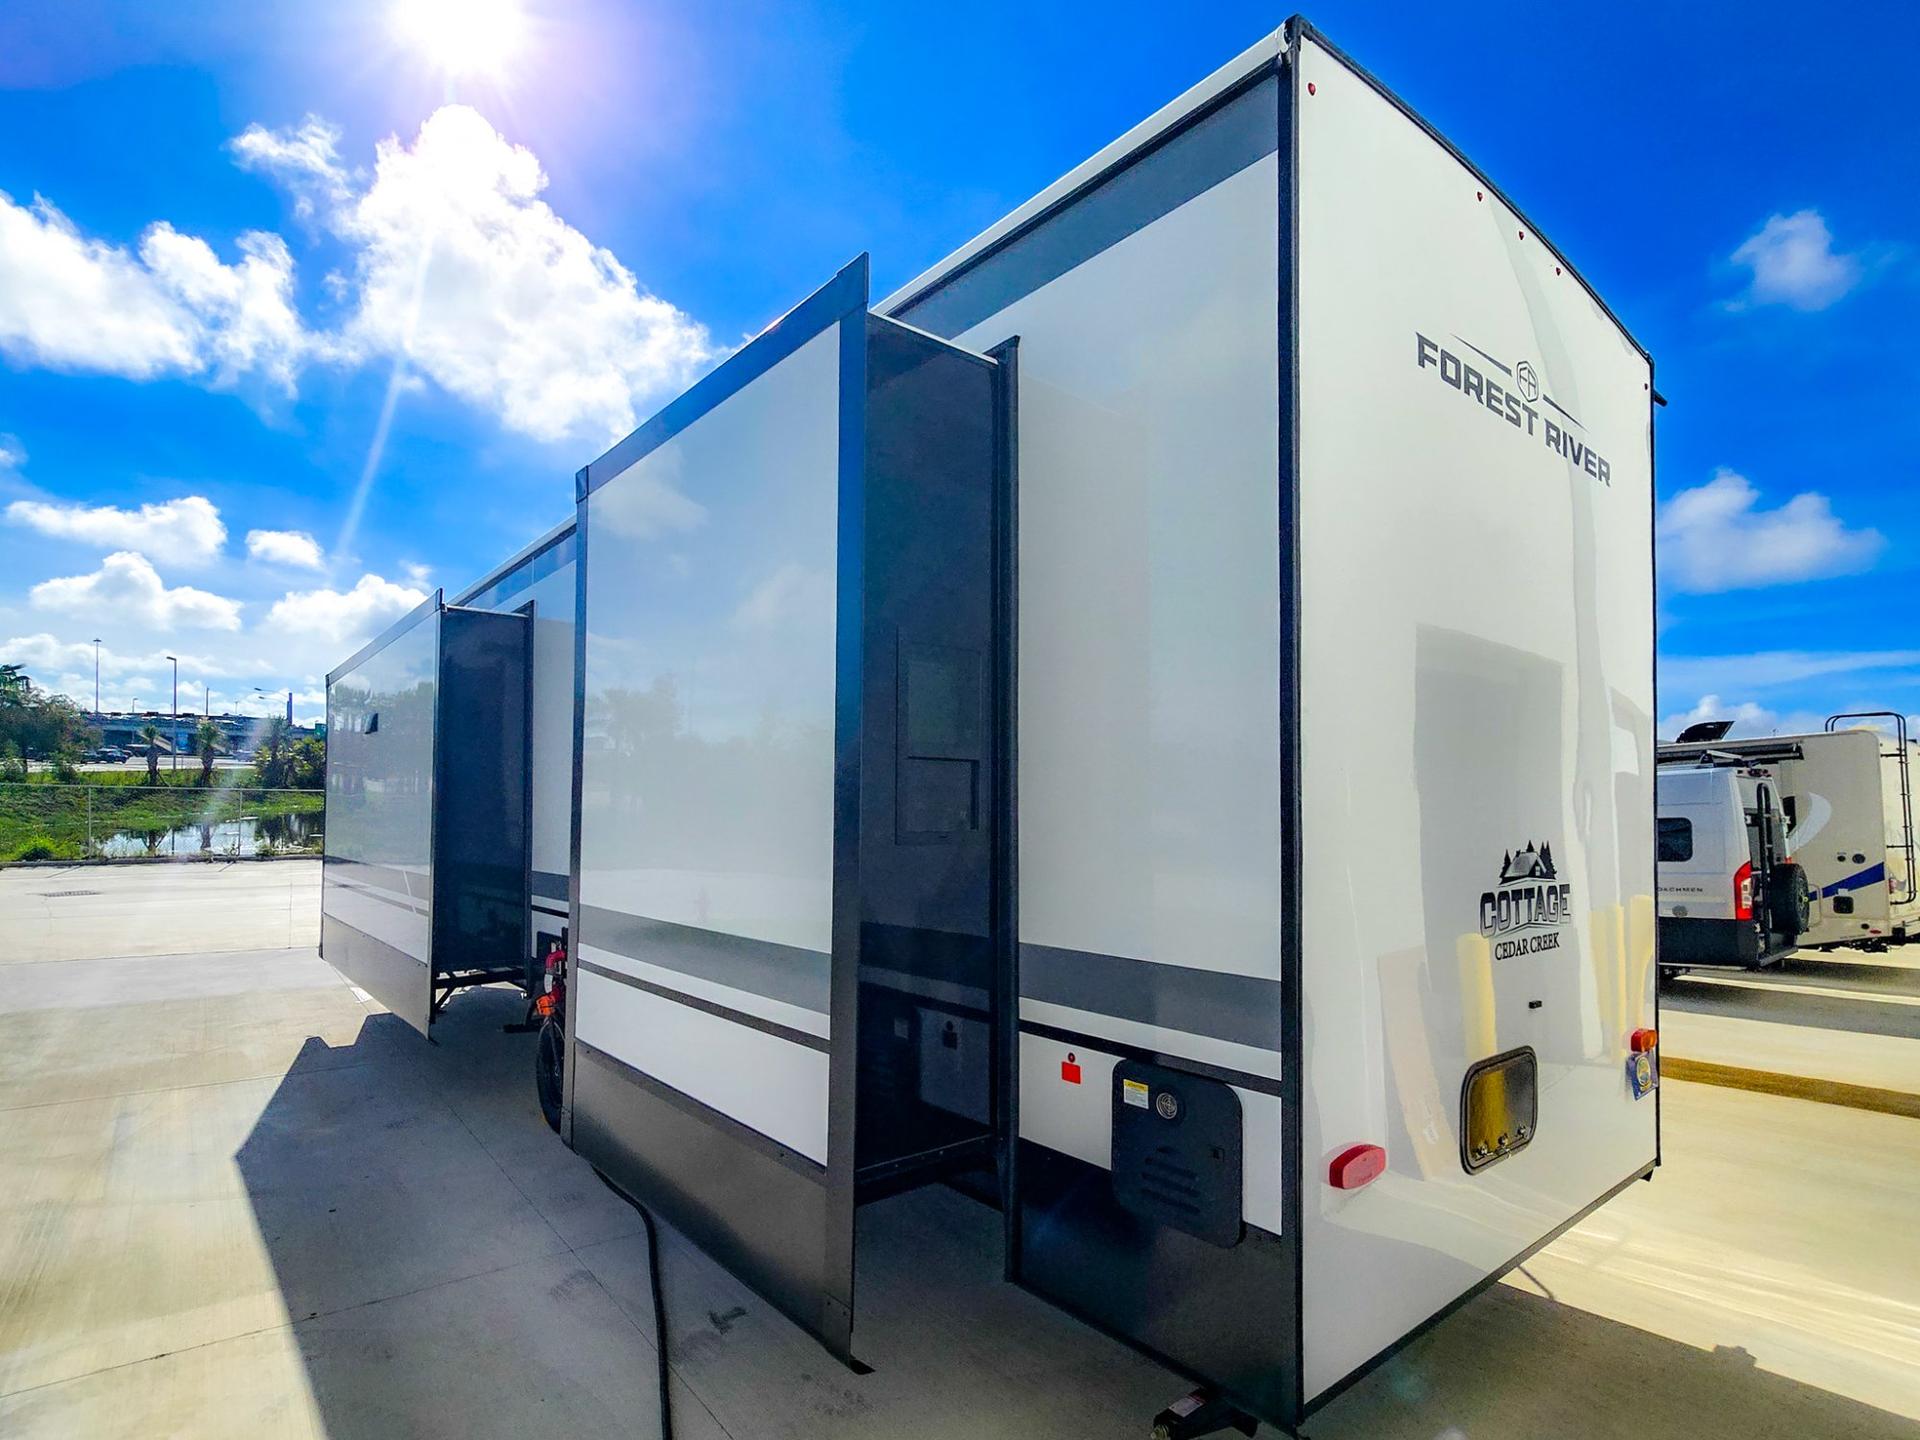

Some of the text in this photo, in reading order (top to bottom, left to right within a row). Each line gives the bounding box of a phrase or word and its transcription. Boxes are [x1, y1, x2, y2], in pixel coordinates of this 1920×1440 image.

[1415, 332, 1611, 487] FOREST RIVER
[1480, 883, 1572, 939] COTTAGE
[1495, 932, 1560, 961] CEDAR CREEK
